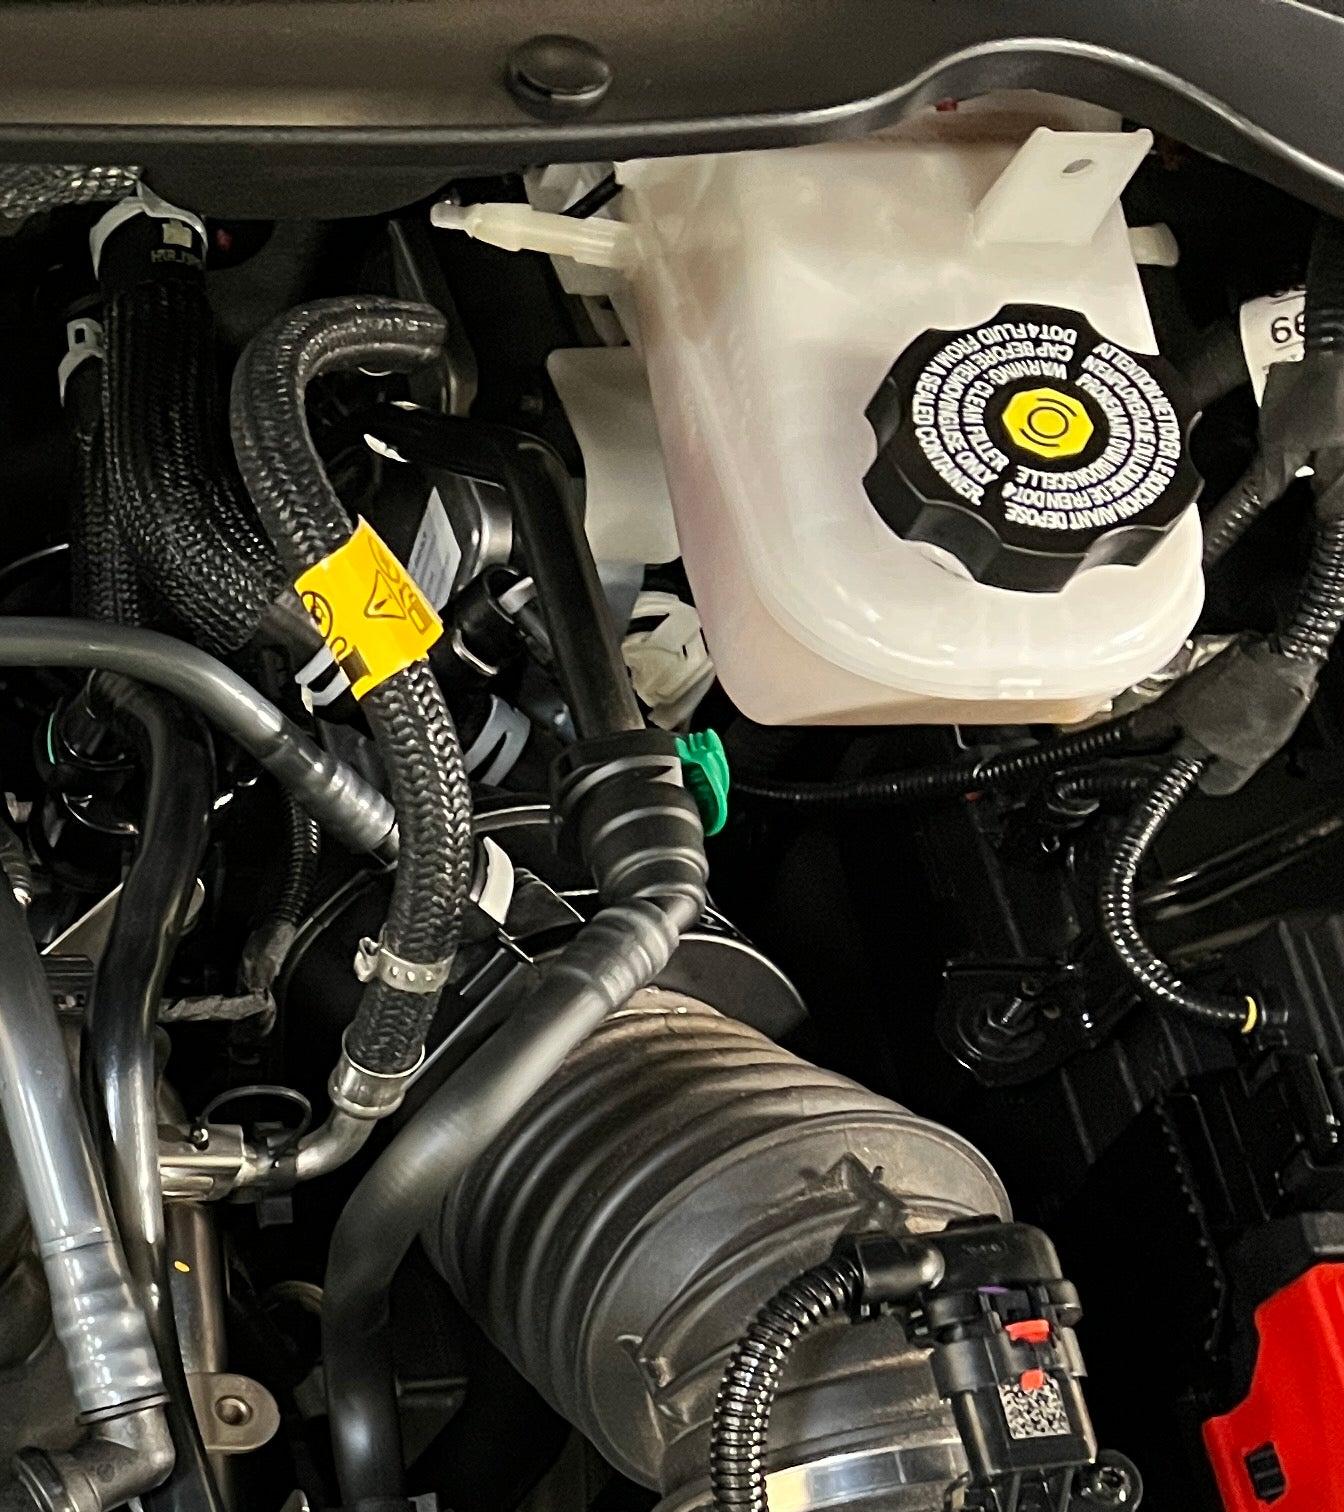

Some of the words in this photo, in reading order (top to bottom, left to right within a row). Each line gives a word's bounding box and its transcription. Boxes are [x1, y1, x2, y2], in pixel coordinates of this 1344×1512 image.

[933, 328, 981, 368] FROM
[976, 323, 1027, 344] FLUID
[1036, 324, 1077, 345] DOT
[969, 340, 1035, 370] BEFORE
[1035, 341, 1073, 361] CAP
[925, 361, 946, 375] A
[912, 372, 941, 425] SEALED
[962, 380, 993, 423] CLEAN
[964, 425, 1009, 471] FILLER
[915, 426, 984, 505] CONTAINER
[955, 450, 998, 484] ONLY
[1011, 486, 1045, 507] DOT
[1111, 470, 1170, 519] BOUCHON
[1068, 504, 1118, 529] AVANT
